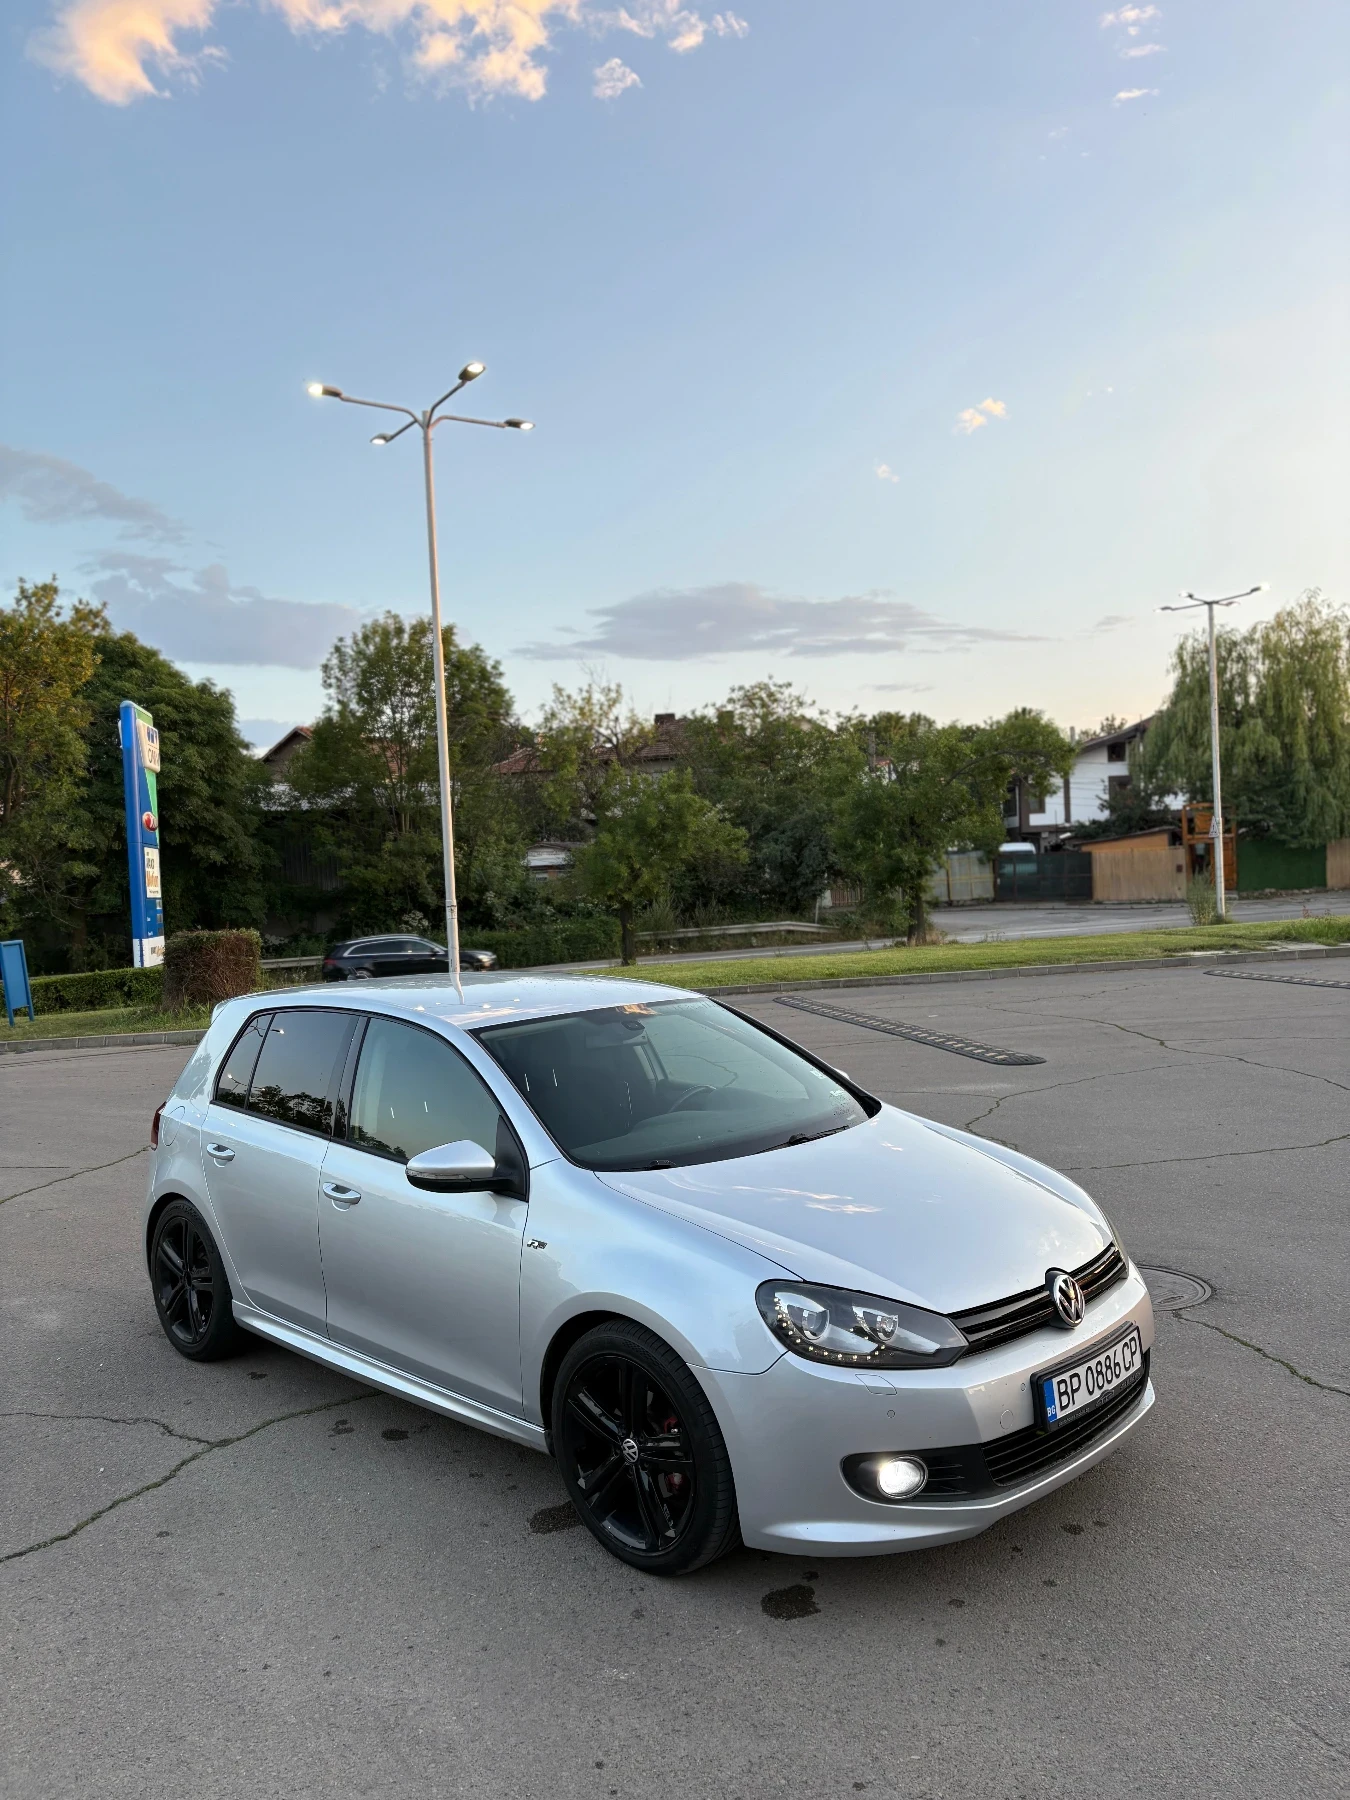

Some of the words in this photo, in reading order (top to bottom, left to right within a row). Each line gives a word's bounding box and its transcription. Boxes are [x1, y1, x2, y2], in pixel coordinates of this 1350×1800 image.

[1057, 1372, 1081, 1411] BP
[1086, 1348, 1121, 1395] 0886
[1122, 1336, 1137, 1371] CP
[1047, 1405, 1056, 1417] BG
